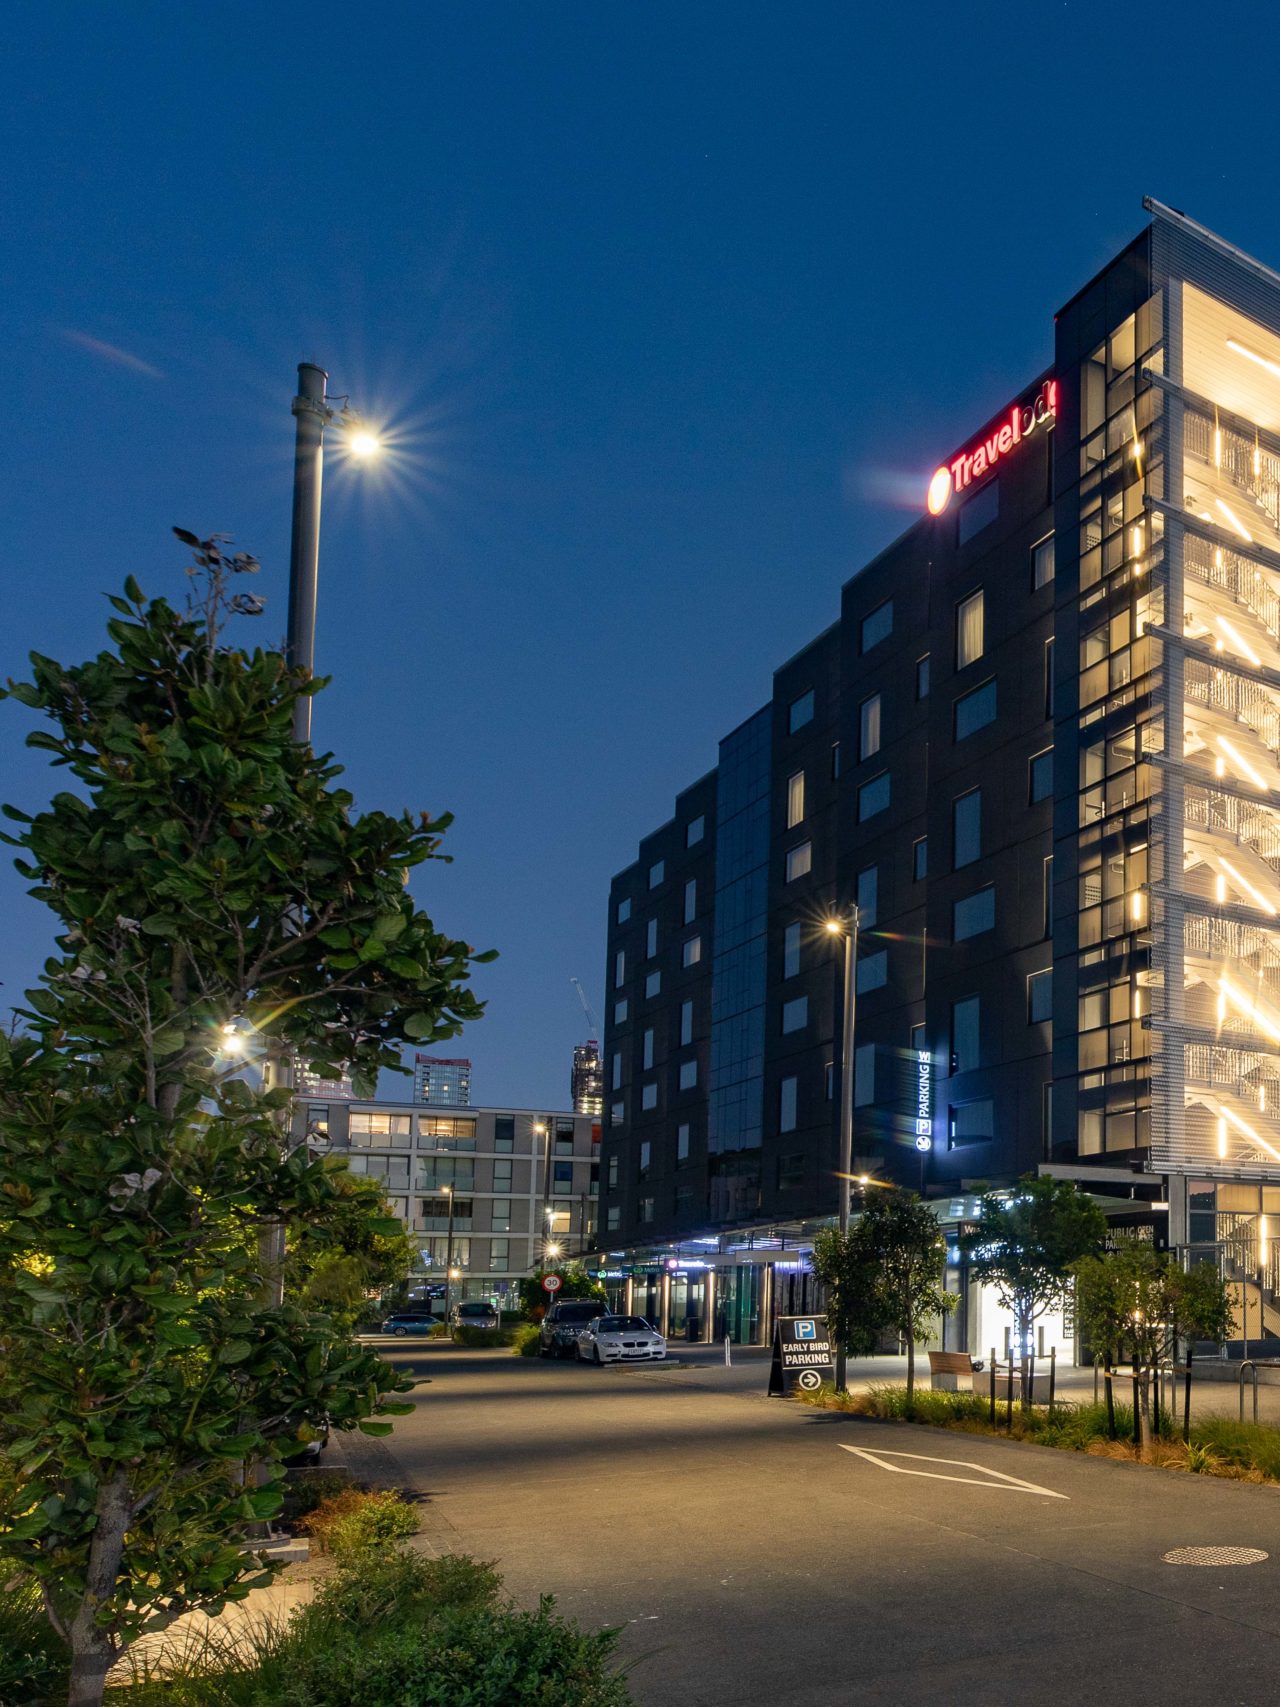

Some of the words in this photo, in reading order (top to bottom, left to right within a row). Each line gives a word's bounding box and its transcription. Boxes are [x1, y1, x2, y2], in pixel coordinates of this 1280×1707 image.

[918, 1064, 930, 1118] PARKING
[1105, 1226, 1135, 1240] PUBLIC
[546, 1279, 558, 1287] 30
[798, 1322, 812, 1338] P
[782, 1343, 808, 1352] EARLY
[809, 1342, 829, 1351] BIRD
[785, 1353, 830, 1365] PARKING
